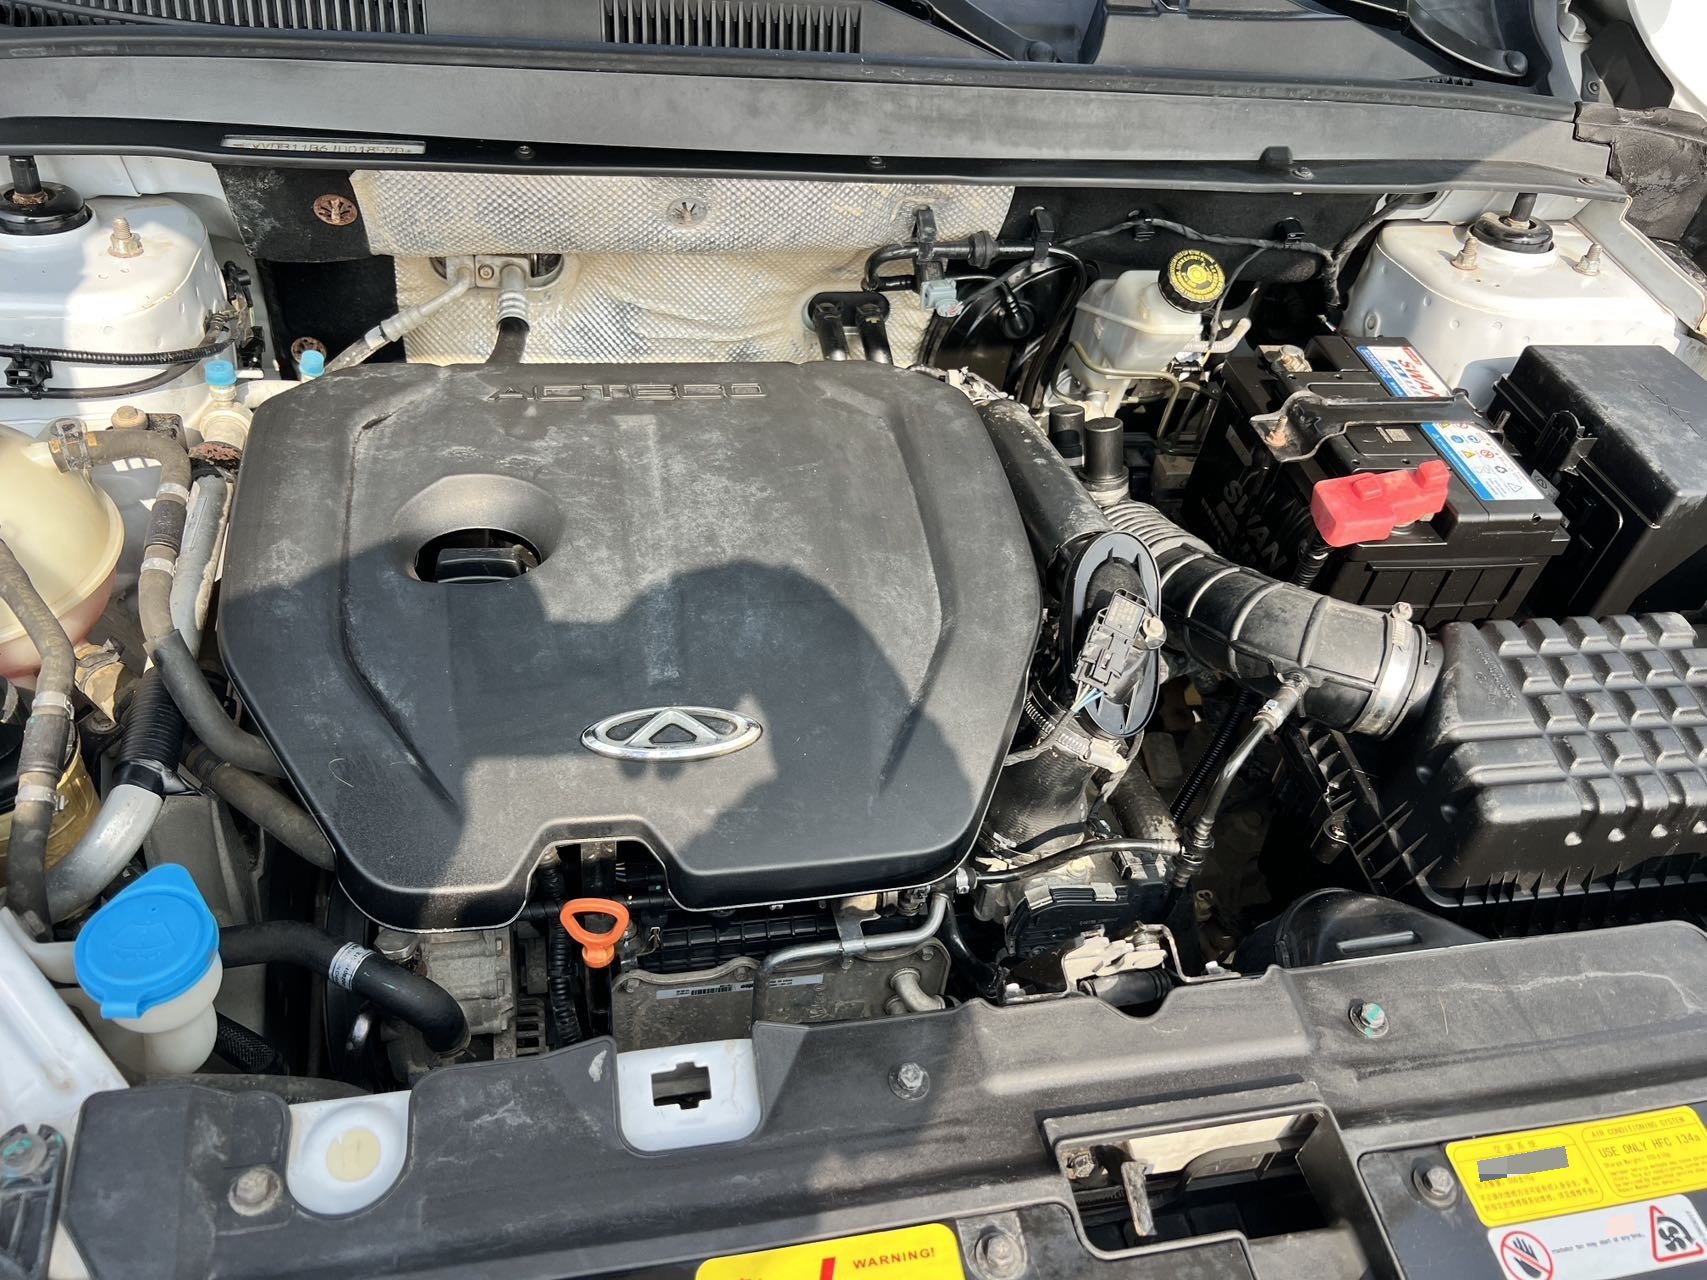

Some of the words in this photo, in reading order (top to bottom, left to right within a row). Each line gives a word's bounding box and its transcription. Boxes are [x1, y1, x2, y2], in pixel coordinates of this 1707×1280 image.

[1591, 1130, 1604, 1138] AIR
[1607, 1121, 1658, 1136] CONDITIONING
[1659, 1116, 1686, 1127] SYSTEM
[1598, 1147, 1621, 1159] USE
[1623, 1141, 1648, 1154] ONLY
[1651, 1137, 1672, 1150] HFC
[1675, 1133, 1702, 1145] 134a
[852, 1247, 936, 1270] WARNING!
